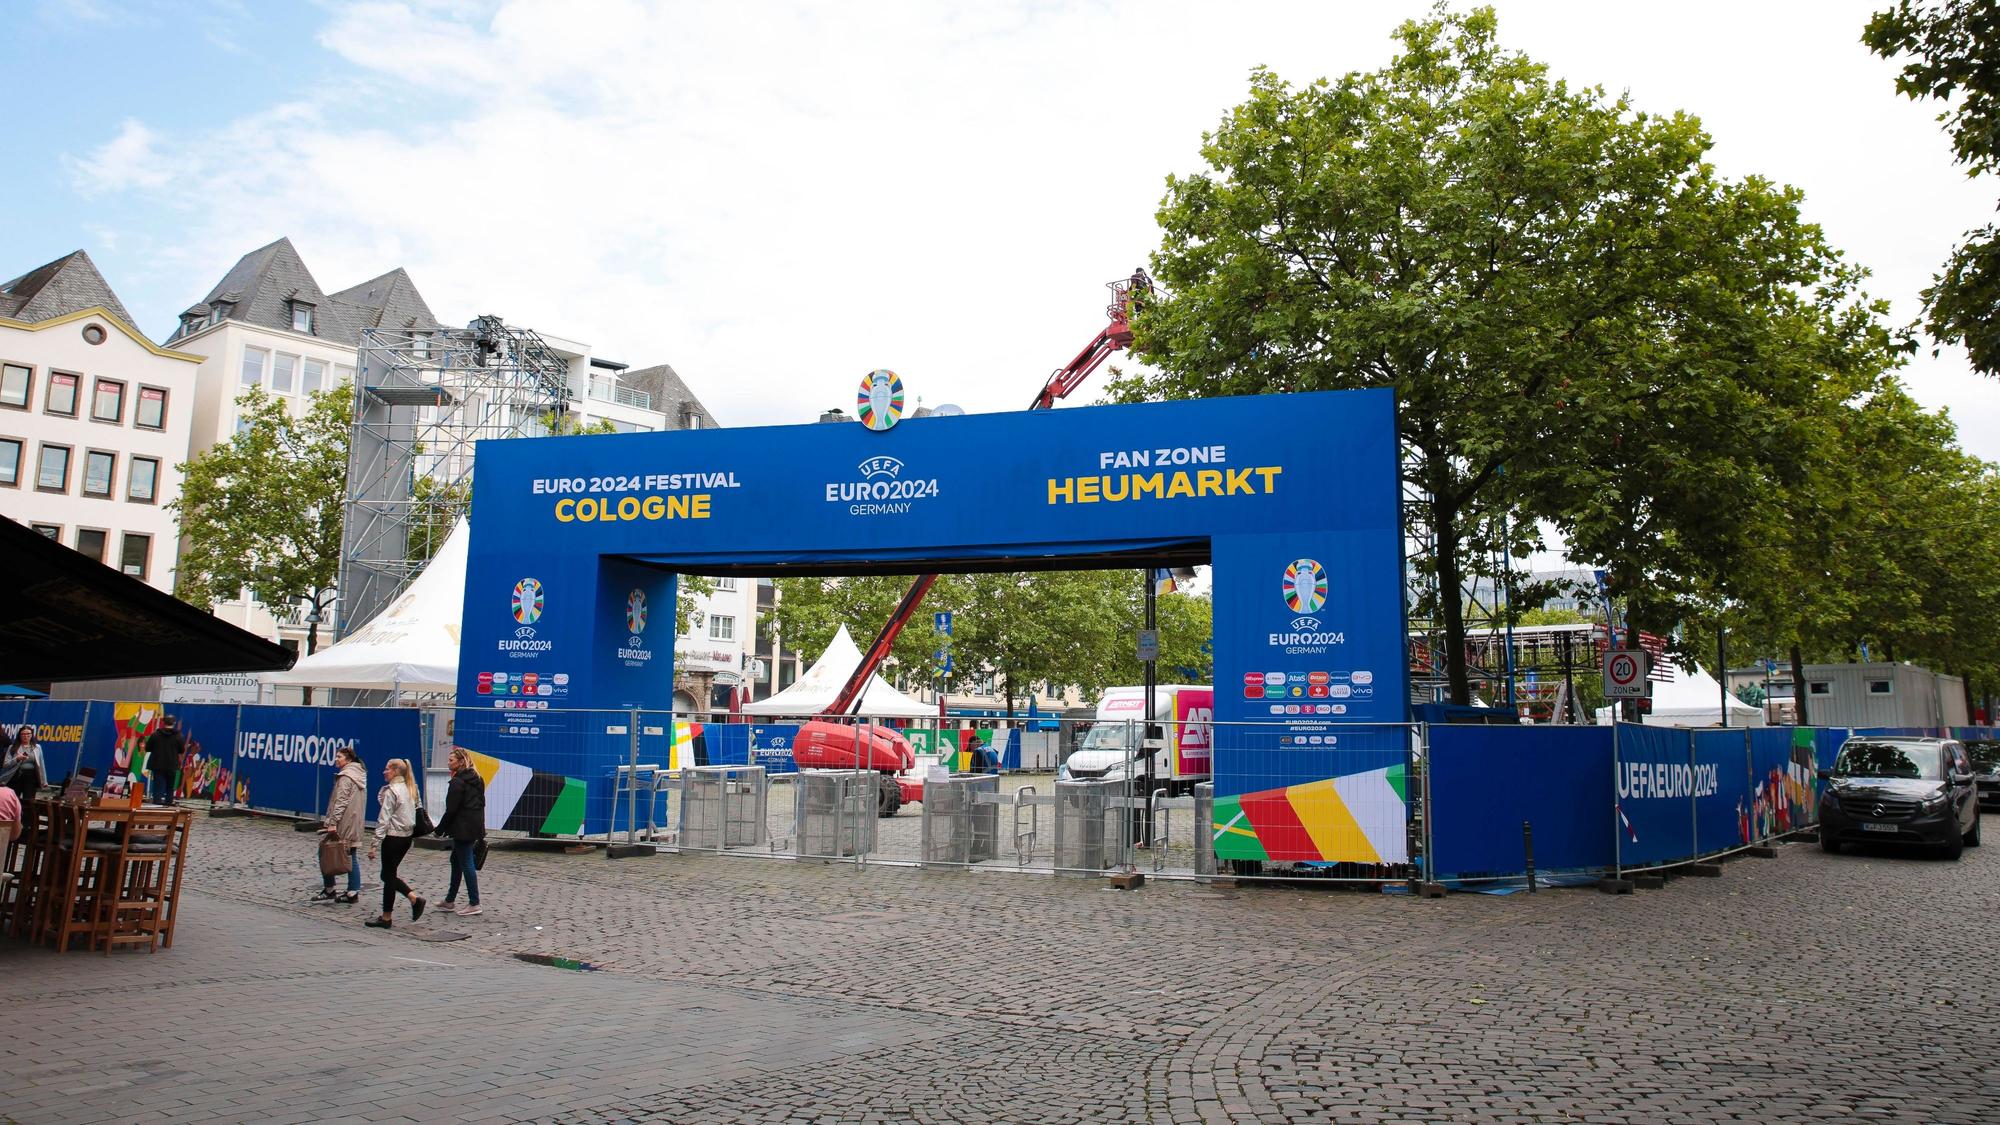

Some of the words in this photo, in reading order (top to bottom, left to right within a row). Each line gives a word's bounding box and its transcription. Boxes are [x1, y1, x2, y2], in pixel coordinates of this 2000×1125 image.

[1100, 450, 1149, 470] FAN
[1155, 445, 1226, 466] ZONE
[860, 460, 900, 476] UEFA
[533, 478, 586, 494] EURO
[589, 476, 641, 493] 2024
[644, 472, 741, 490] FESTIVAL
[1047, 466, 1282, 505] HEUMARKT
[555, 494, 711, 523] COLOGNE
[849, 502, 912, 516] GERMANY
[1292, 618, 1319, 629] UEFA
[515, 628, 535, 638] UEFA
[509, 651, 539, 659] GERMANY
[1615, 662, 1631, 676] 20
[1613, 686, 1634, 695] ZONE
[37, 724, 83, 743] COLOGNE
